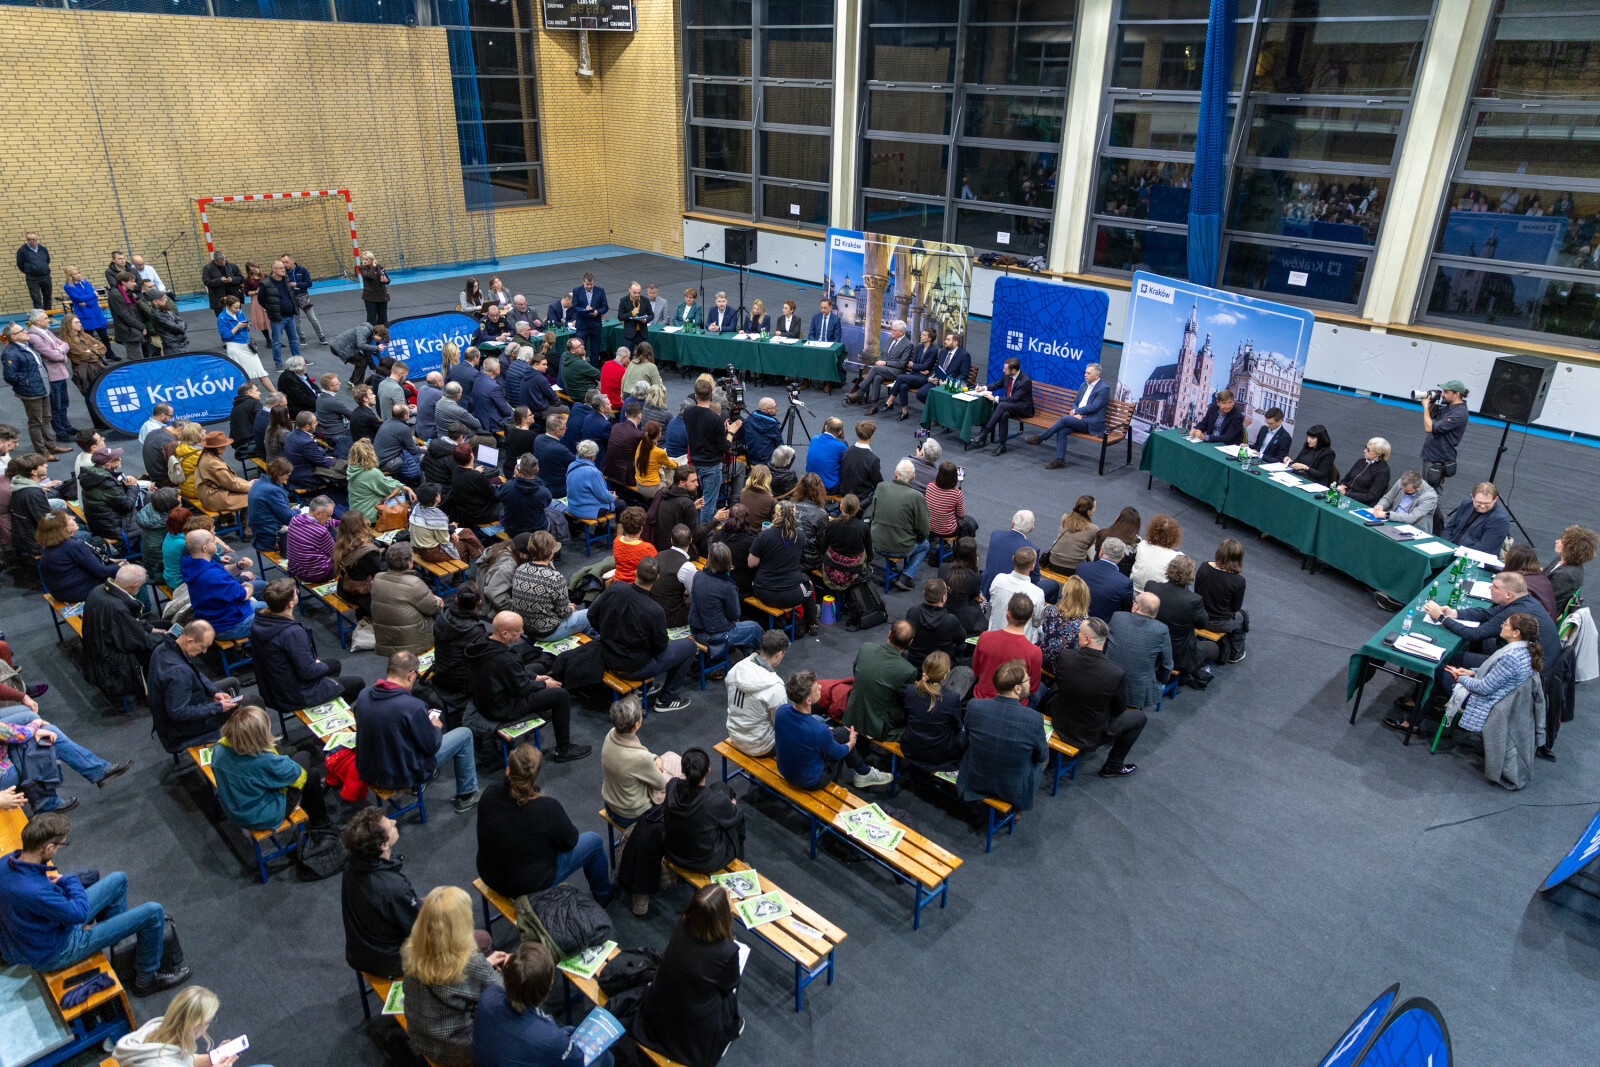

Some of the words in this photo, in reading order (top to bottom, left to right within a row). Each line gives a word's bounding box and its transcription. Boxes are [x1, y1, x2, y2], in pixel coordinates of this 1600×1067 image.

[842, 240, 861, 249] Kraków
[1149, 287, 1170, 298] Kraków
[1028, 337, 1083, 361] Kraków
[146, 375, 235, 404] Kraków
